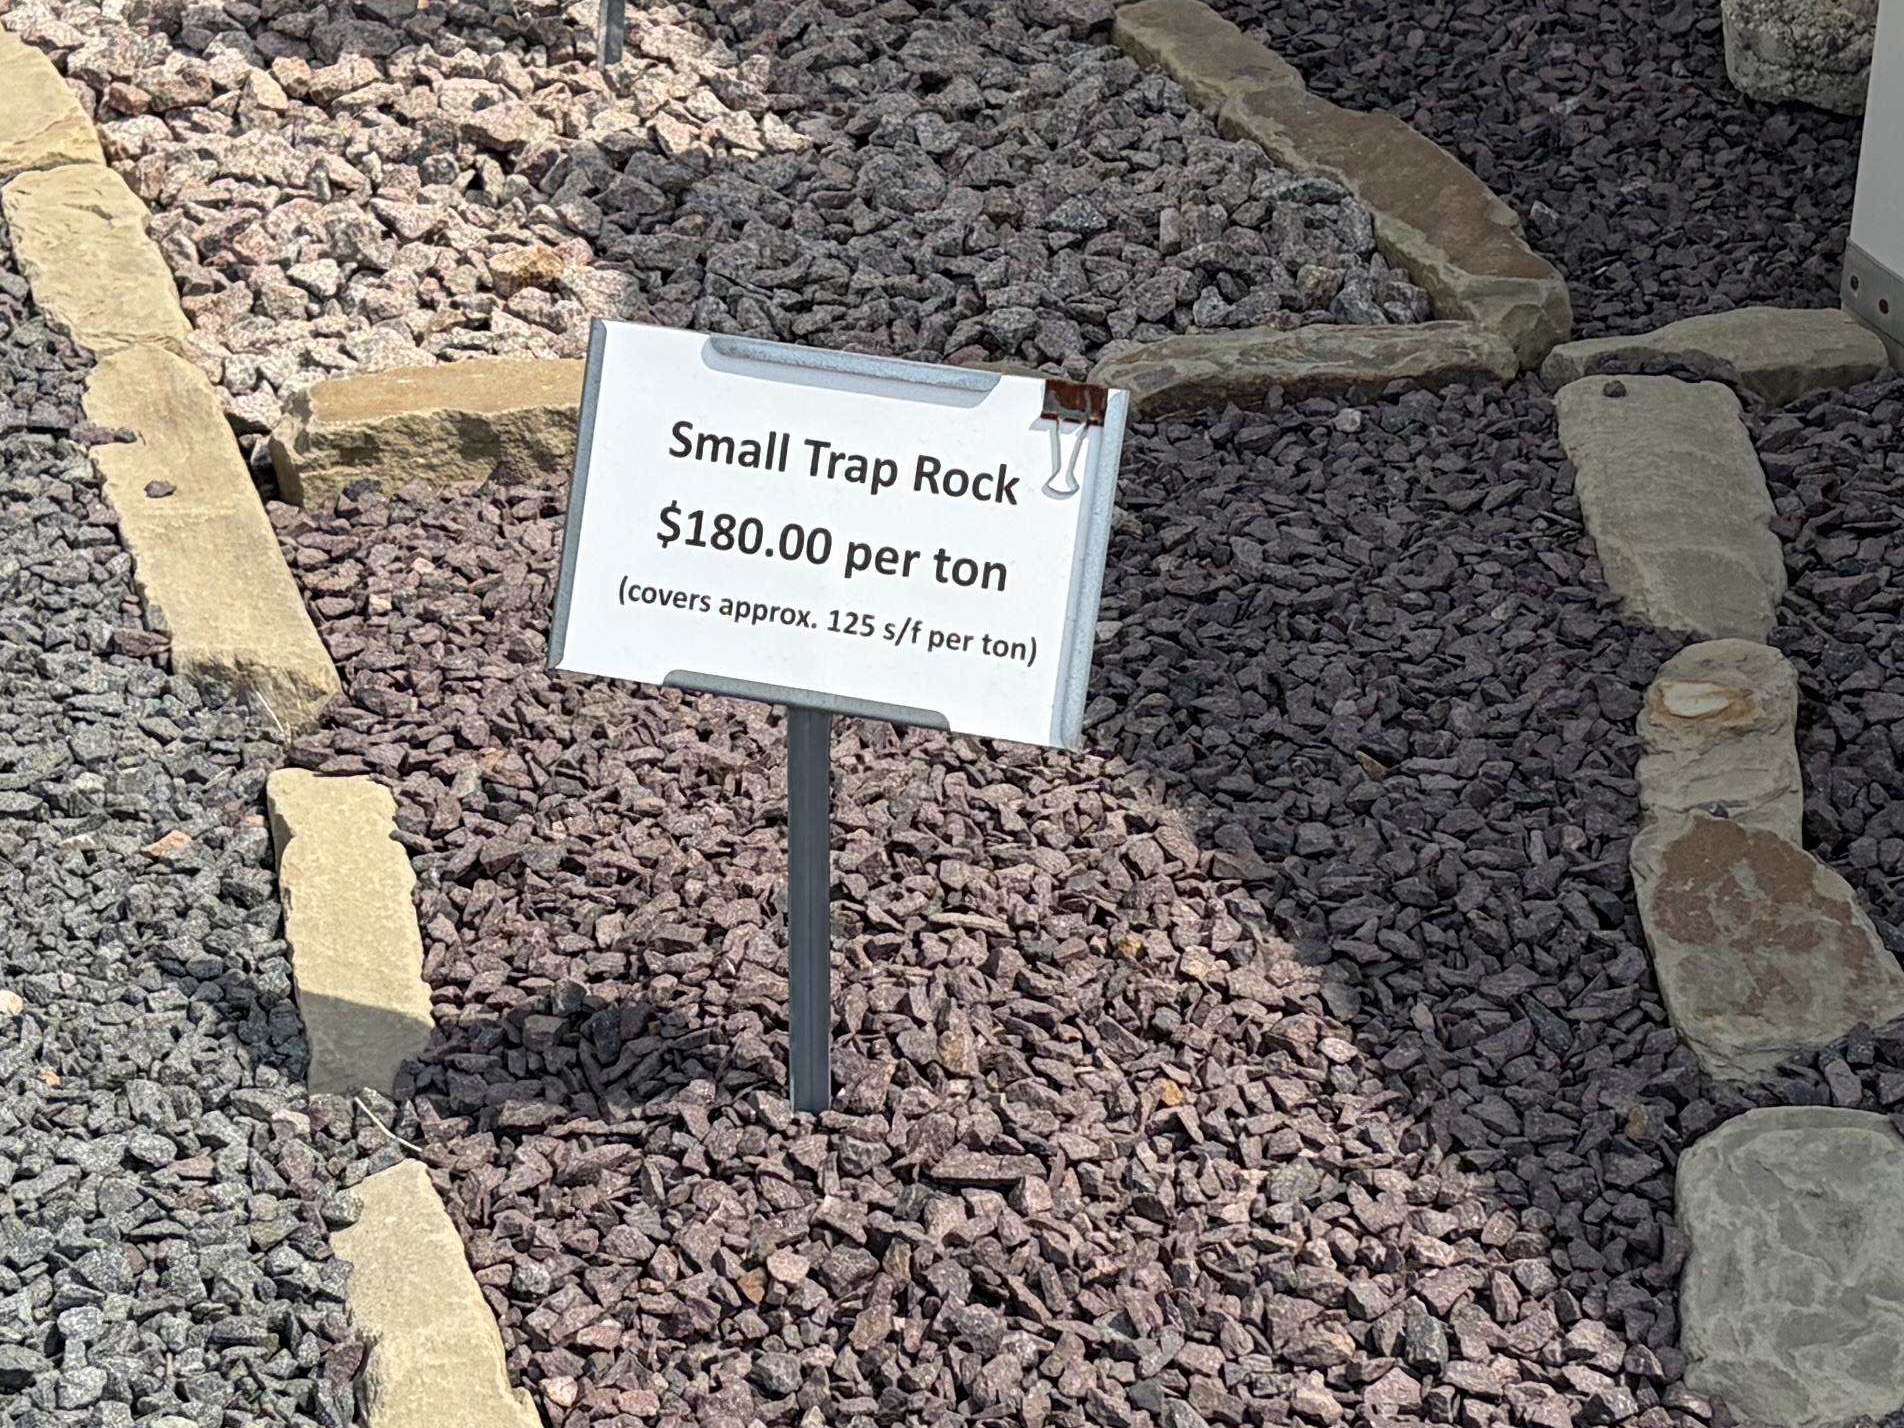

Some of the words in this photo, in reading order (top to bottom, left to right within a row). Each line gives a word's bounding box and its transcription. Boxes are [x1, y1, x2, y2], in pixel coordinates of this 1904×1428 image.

[668, 420, 791, 473] Small
[803, 438, 898, 496] Trap
[913, 454, 1021, 506] Rock
[656, 499, 833, 565] $180.00
[843, 541, 921, 579] per
[933, 547, 1007, 592] ton
[618, 575, 712, 613] (covers
[718, 598, 817, 629] approx.
[827, 609, 876, 638] 125
[882, 616, 923, 647] s/f
[927, 629, 975, 653] per
[981, 633, 1037, 668] ton)
